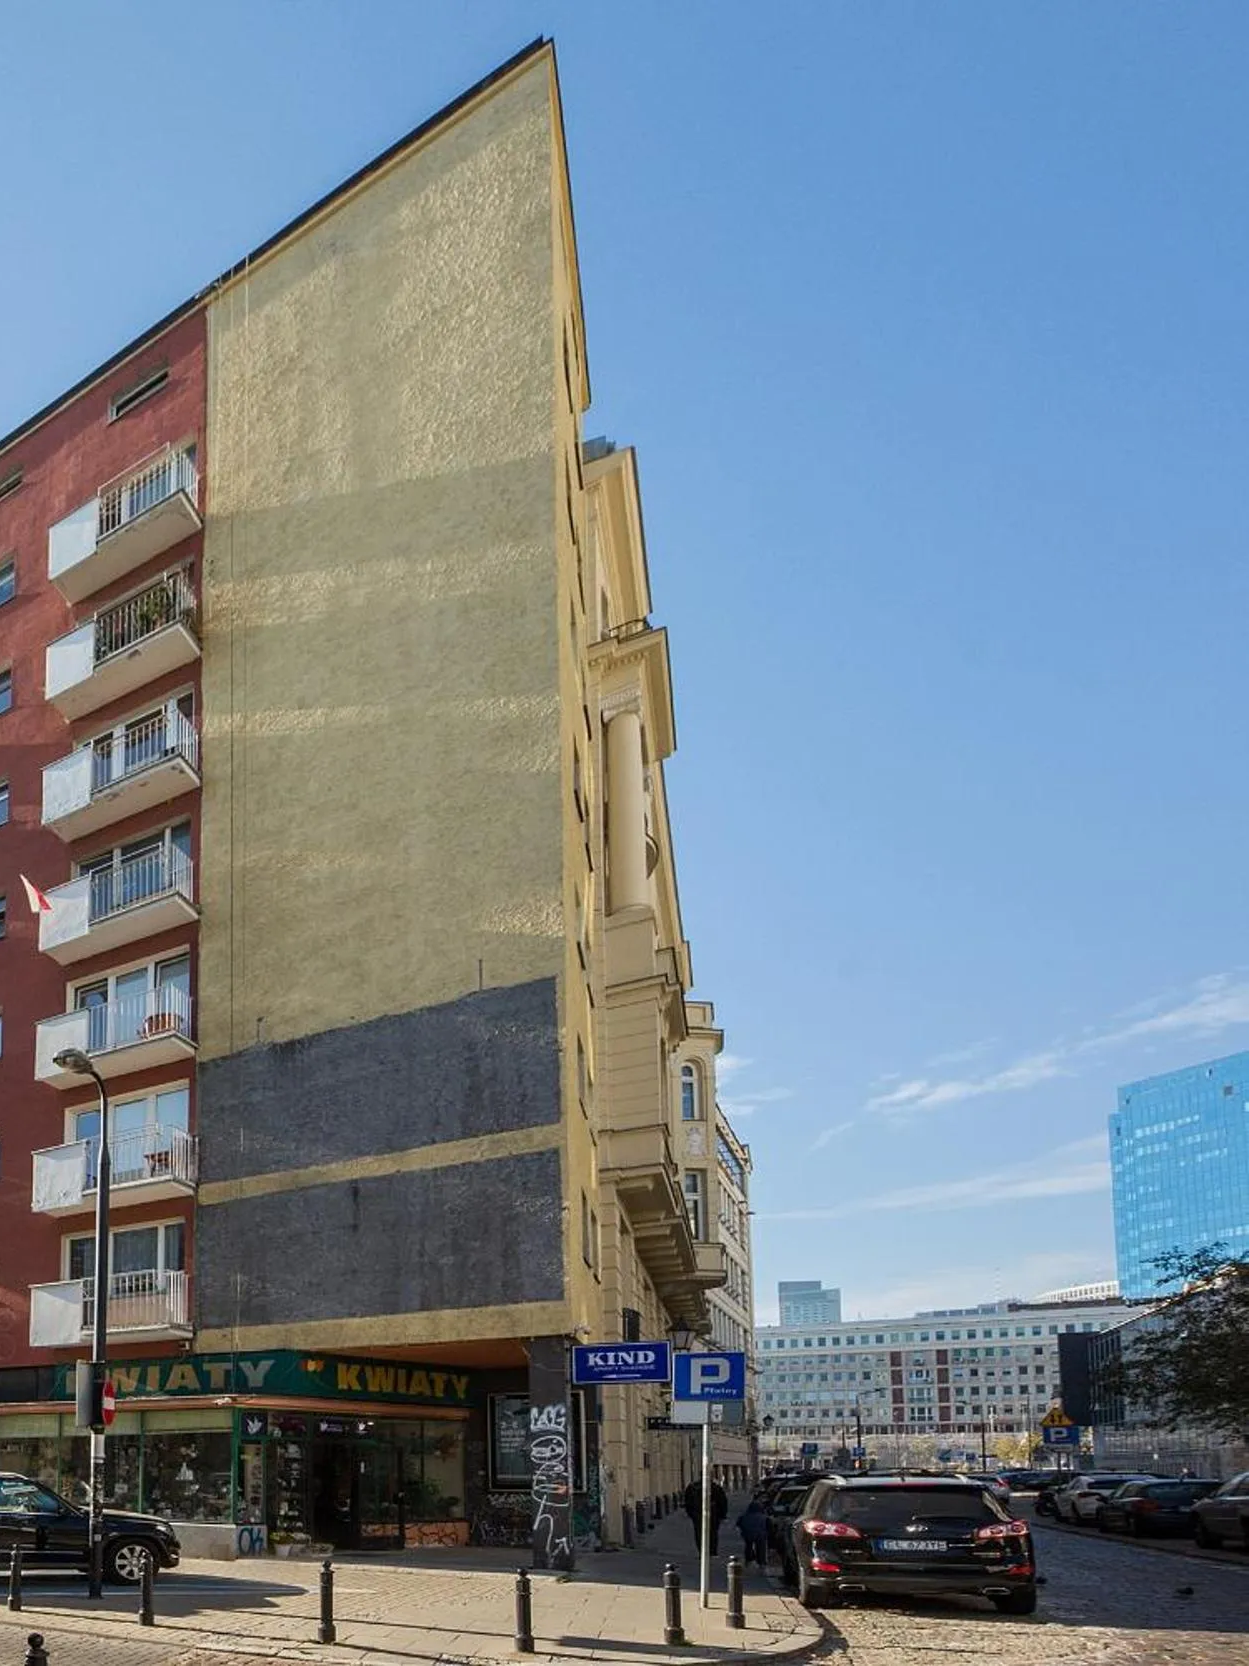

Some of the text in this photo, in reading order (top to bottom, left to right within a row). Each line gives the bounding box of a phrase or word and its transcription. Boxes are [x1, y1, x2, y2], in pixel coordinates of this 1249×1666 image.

[587, 1350, 655, 1366] KIND
[337, 1362, 468, 1399] KWIATY
[690, 1357, 730, 1394] P
[1050, 1428, 1067, 1442] P
